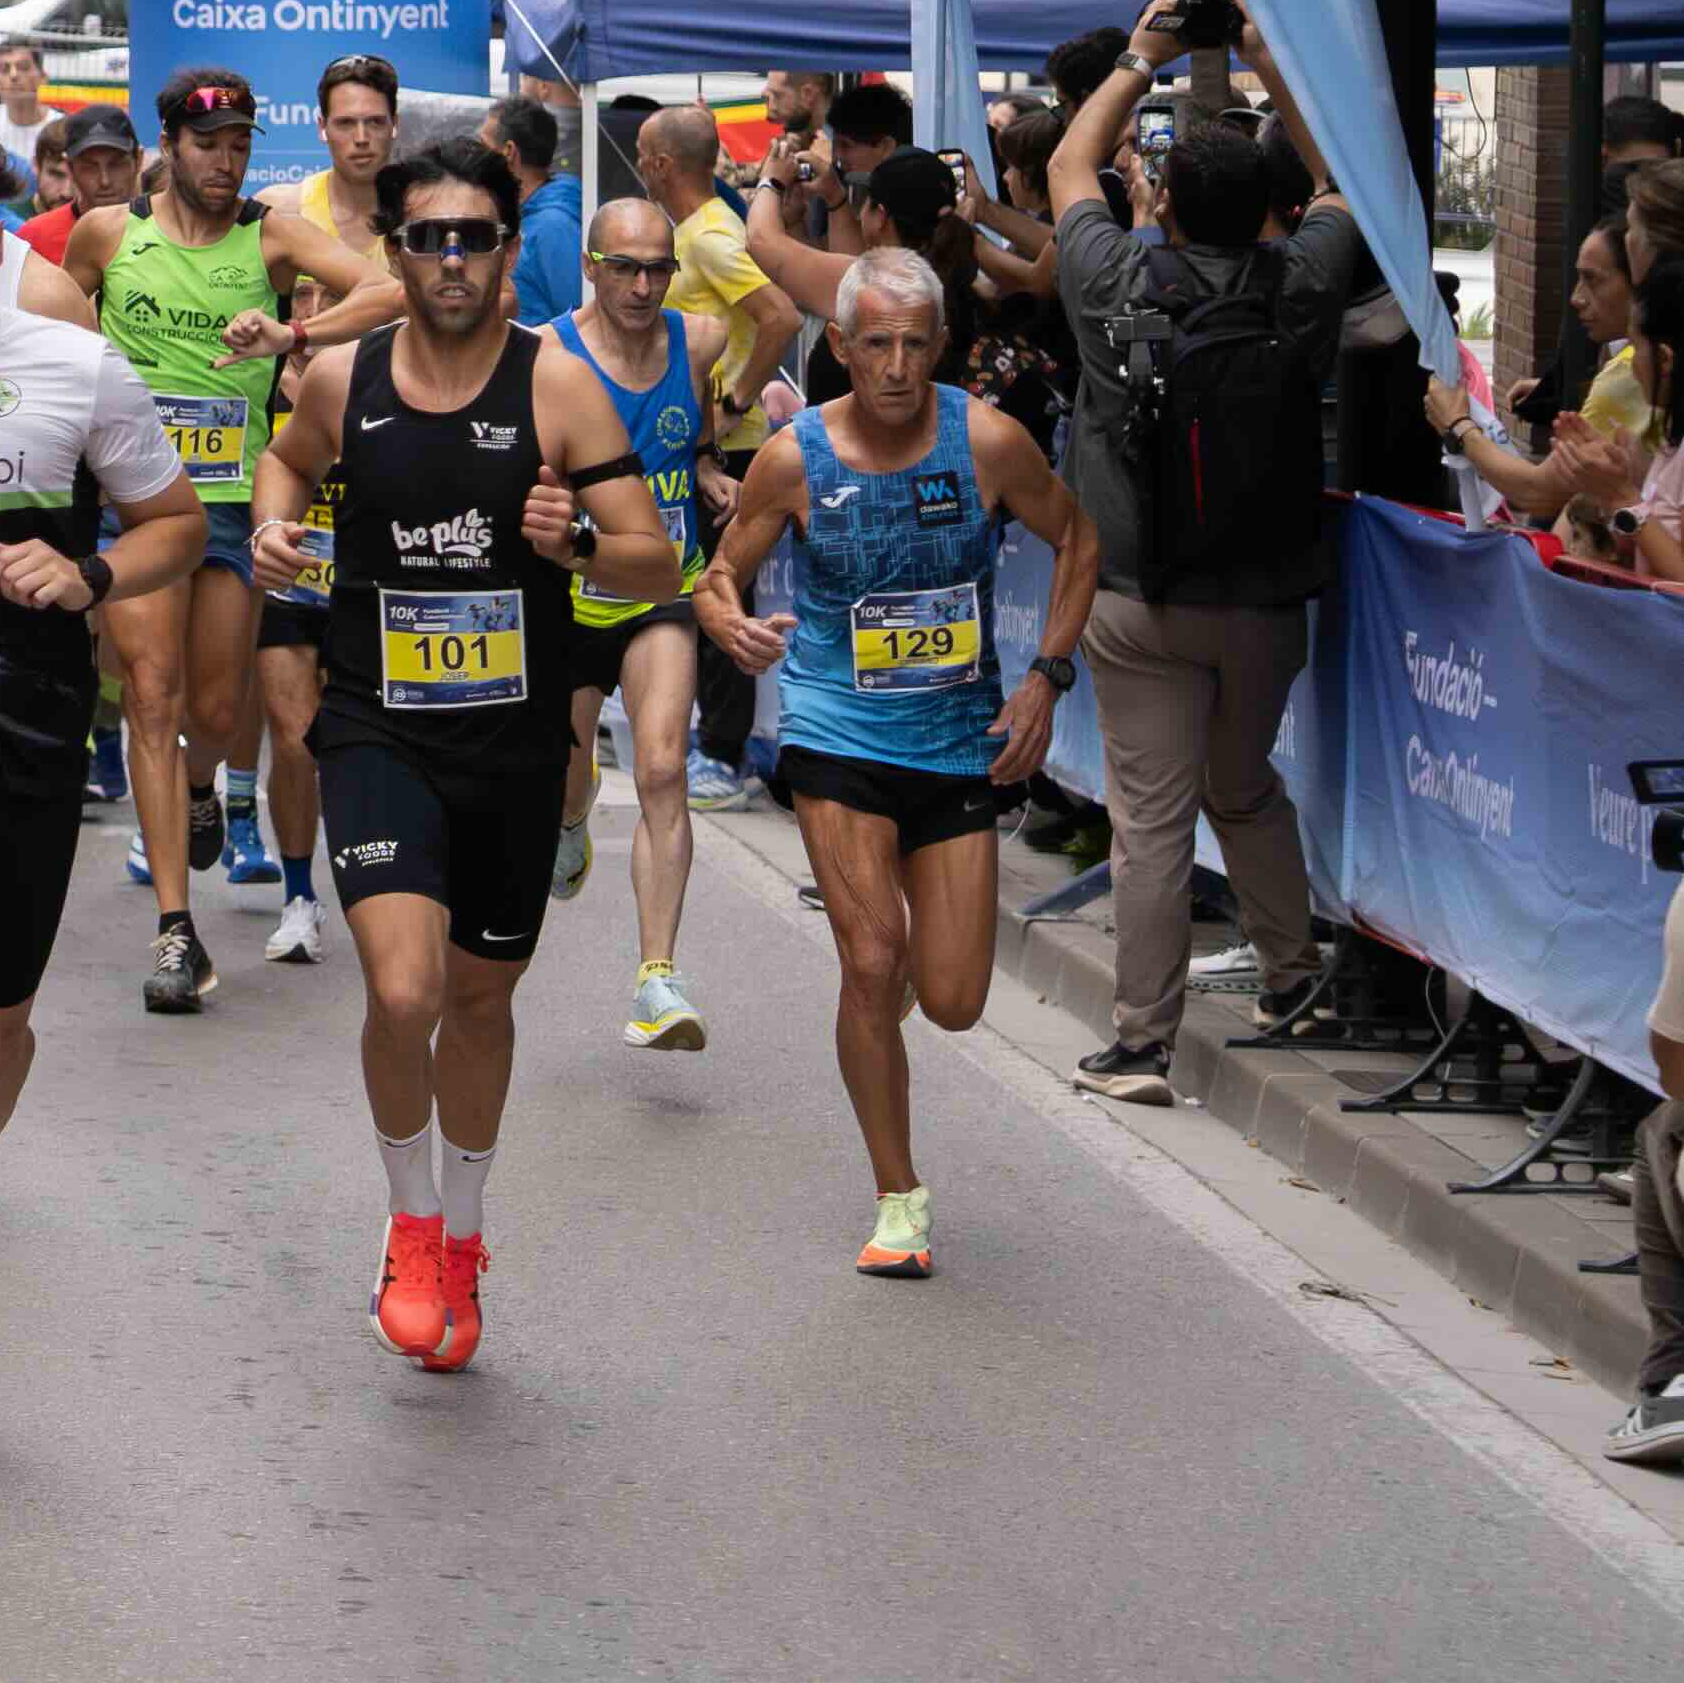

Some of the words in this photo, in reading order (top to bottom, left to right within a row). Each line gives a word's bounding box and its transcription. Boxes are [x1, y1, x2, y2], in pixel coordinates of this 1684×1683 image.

[171, 428, 223, 454] 116
[391, 520, 427, 550] be
[430, 508, 493, 555] plus
[400, 555, 440, 567] NATURAL
[389, 605, 419, 621] 10K
[859, 605, 886, 619] 10K
[414, 635, 489, 671] 101
[883, 627, 954, 660] 129
[1405, 630, 1484, 721] Fundació
[353, 841, 399, 855] VICKY
